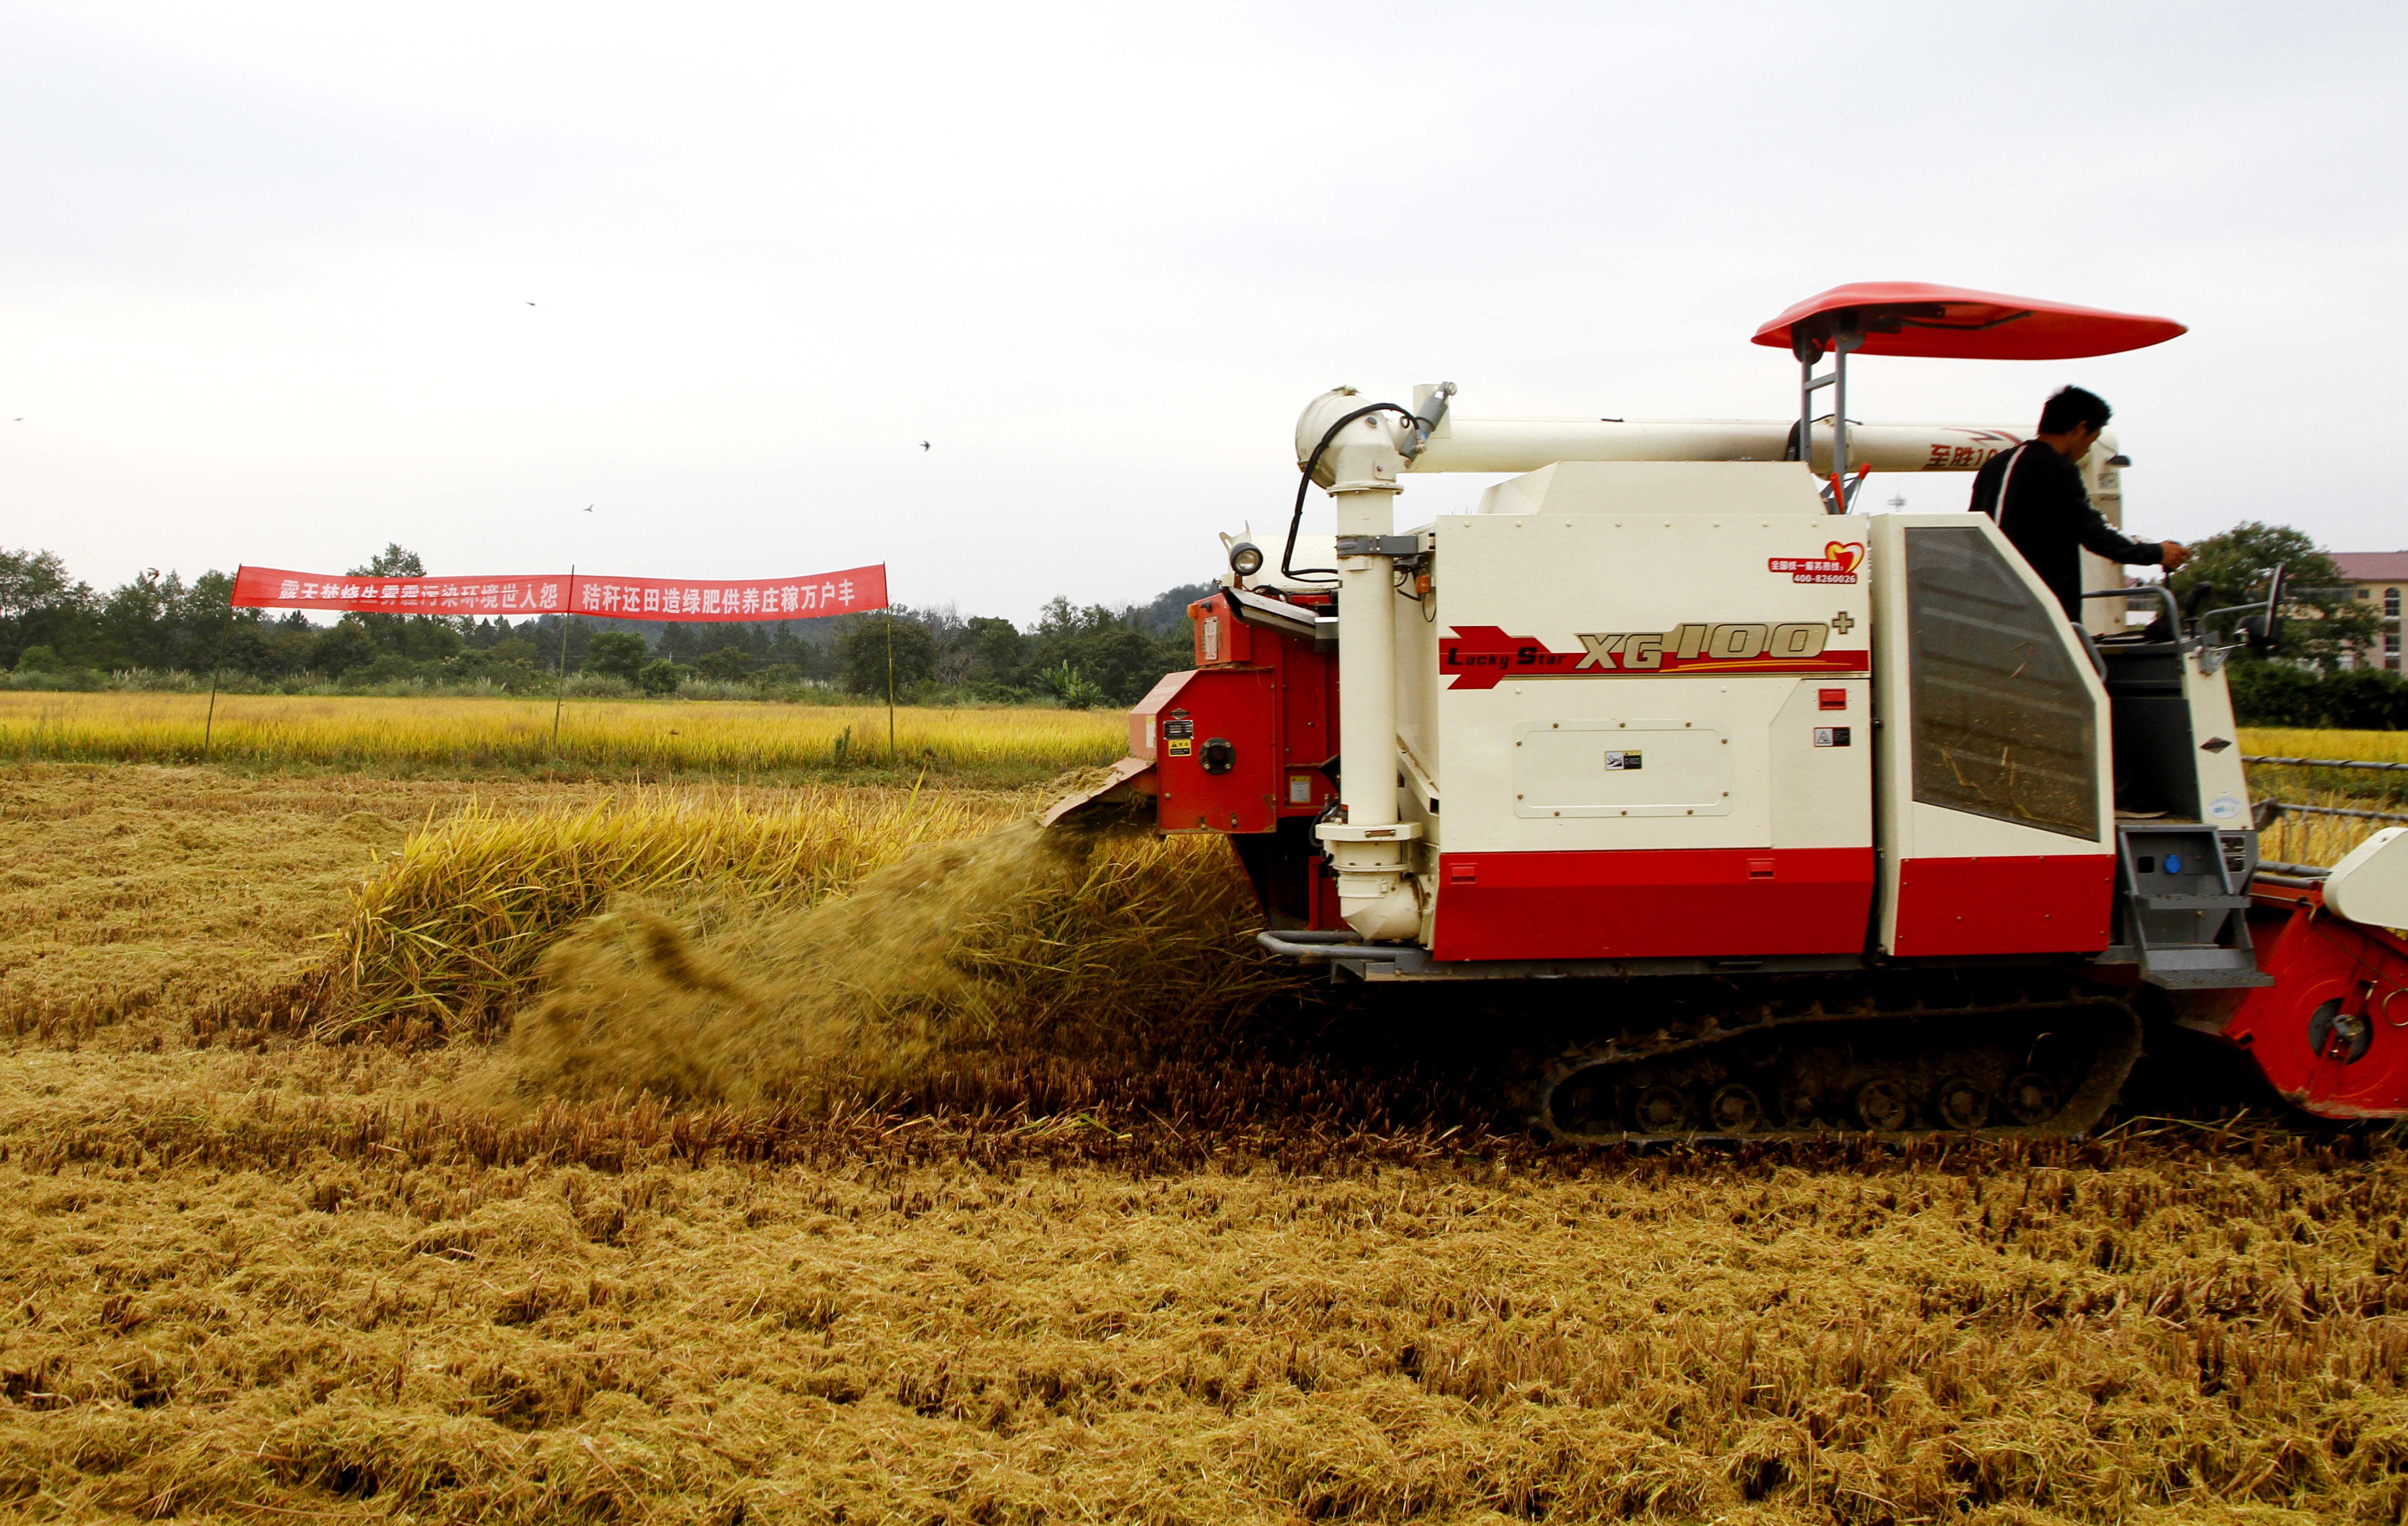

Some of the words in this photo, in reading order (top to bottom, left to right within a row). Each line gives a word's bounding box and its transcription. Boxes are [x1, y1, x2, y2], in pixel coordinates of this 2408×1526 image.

[1793, 574, 1856, 583] 400-8260026
[582, 579, 855, 614] 秸秆还田造绿肥供养庄稼万户丰
[1447, 647, 1510, 669] Lucky
[1516, 647, 1566, 666] Star
